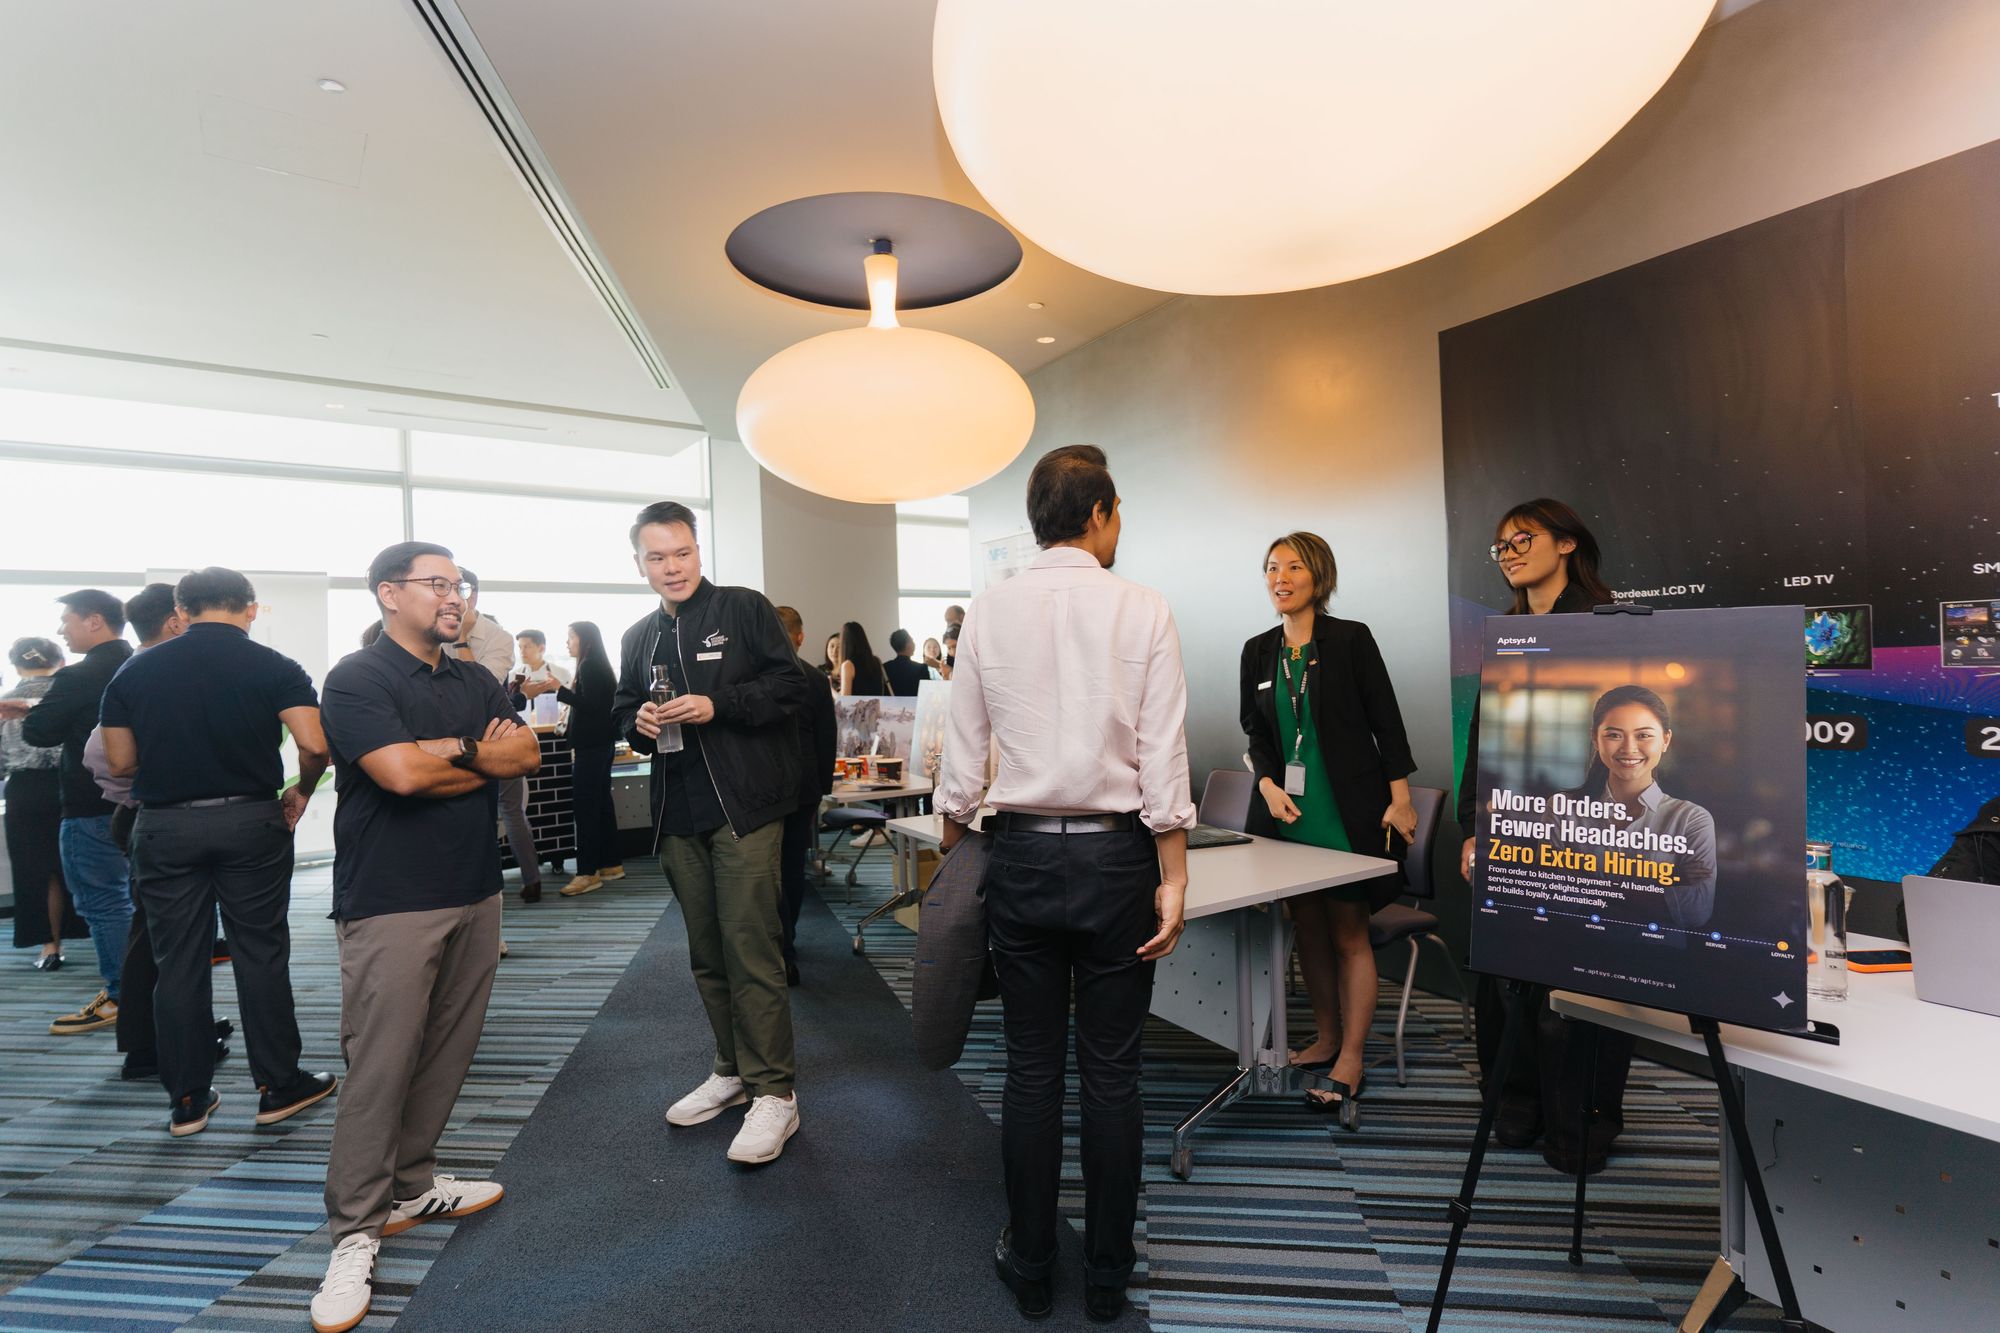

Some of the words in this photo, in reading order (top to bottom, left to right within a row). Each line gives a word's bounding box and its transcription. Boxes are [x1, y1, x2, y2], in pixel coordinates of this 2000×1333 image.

[1611, 587, 1660, 599] Bordeaux
[1662, 585, 1687, 596] LCD
[1689, 584, 1705, 595] TV
[1784, 575, 1811, 587] LED
[1814, 574, 1834, 585] TV
[1497, 637, 1526, 646] Aptsys
[1526, 636, 1537, 644] AI
[1491, 788, 1546, 813] More
[1552, 793, 1633, 822] Orders.
[1490, 813, 1555, 840] Fewer
[1560, 819, 1695, 855] Headaches.
[1488, 838, 1534, 864] Zero
[1540, 844, 1597, 872] Extra
[1604, 850, 1681, 886] Hiring.
[1487, 876, 1514, 885] service
[1514, 879, 1548, 890] recovery,
[1549, 883, 1579, 893] delights
[1581, 888, 1625, 900] customers,
[1488, 864, 1506, 874] From
[1508, 867, 1527, 877] order
[1529, 870, 1537, 878] to
[1538, 871, 1566, 882] kitchen
[1567, 875, 1575, 883] to
[1576, 877, 1611, 888] payment
[1620, 881, 1630, 889] AI
[1631, 882, 1664, 893] handles
[1487, 884, 1502, 892] and
[1502, 886, 1524, 896] builds
[1525, 889, 1551, 900] loyalty.
[1552, 893, 1608, 908] Automatically.
[1641, 931, 1665, 940] PAYMENT
[1705, 941, 1727, 950] SERVICE
[1770, 951, 1795, 960] LOYALTY
[1573, 965, 1676, 989] www.aptsys.com.sg/aptsys-ai
